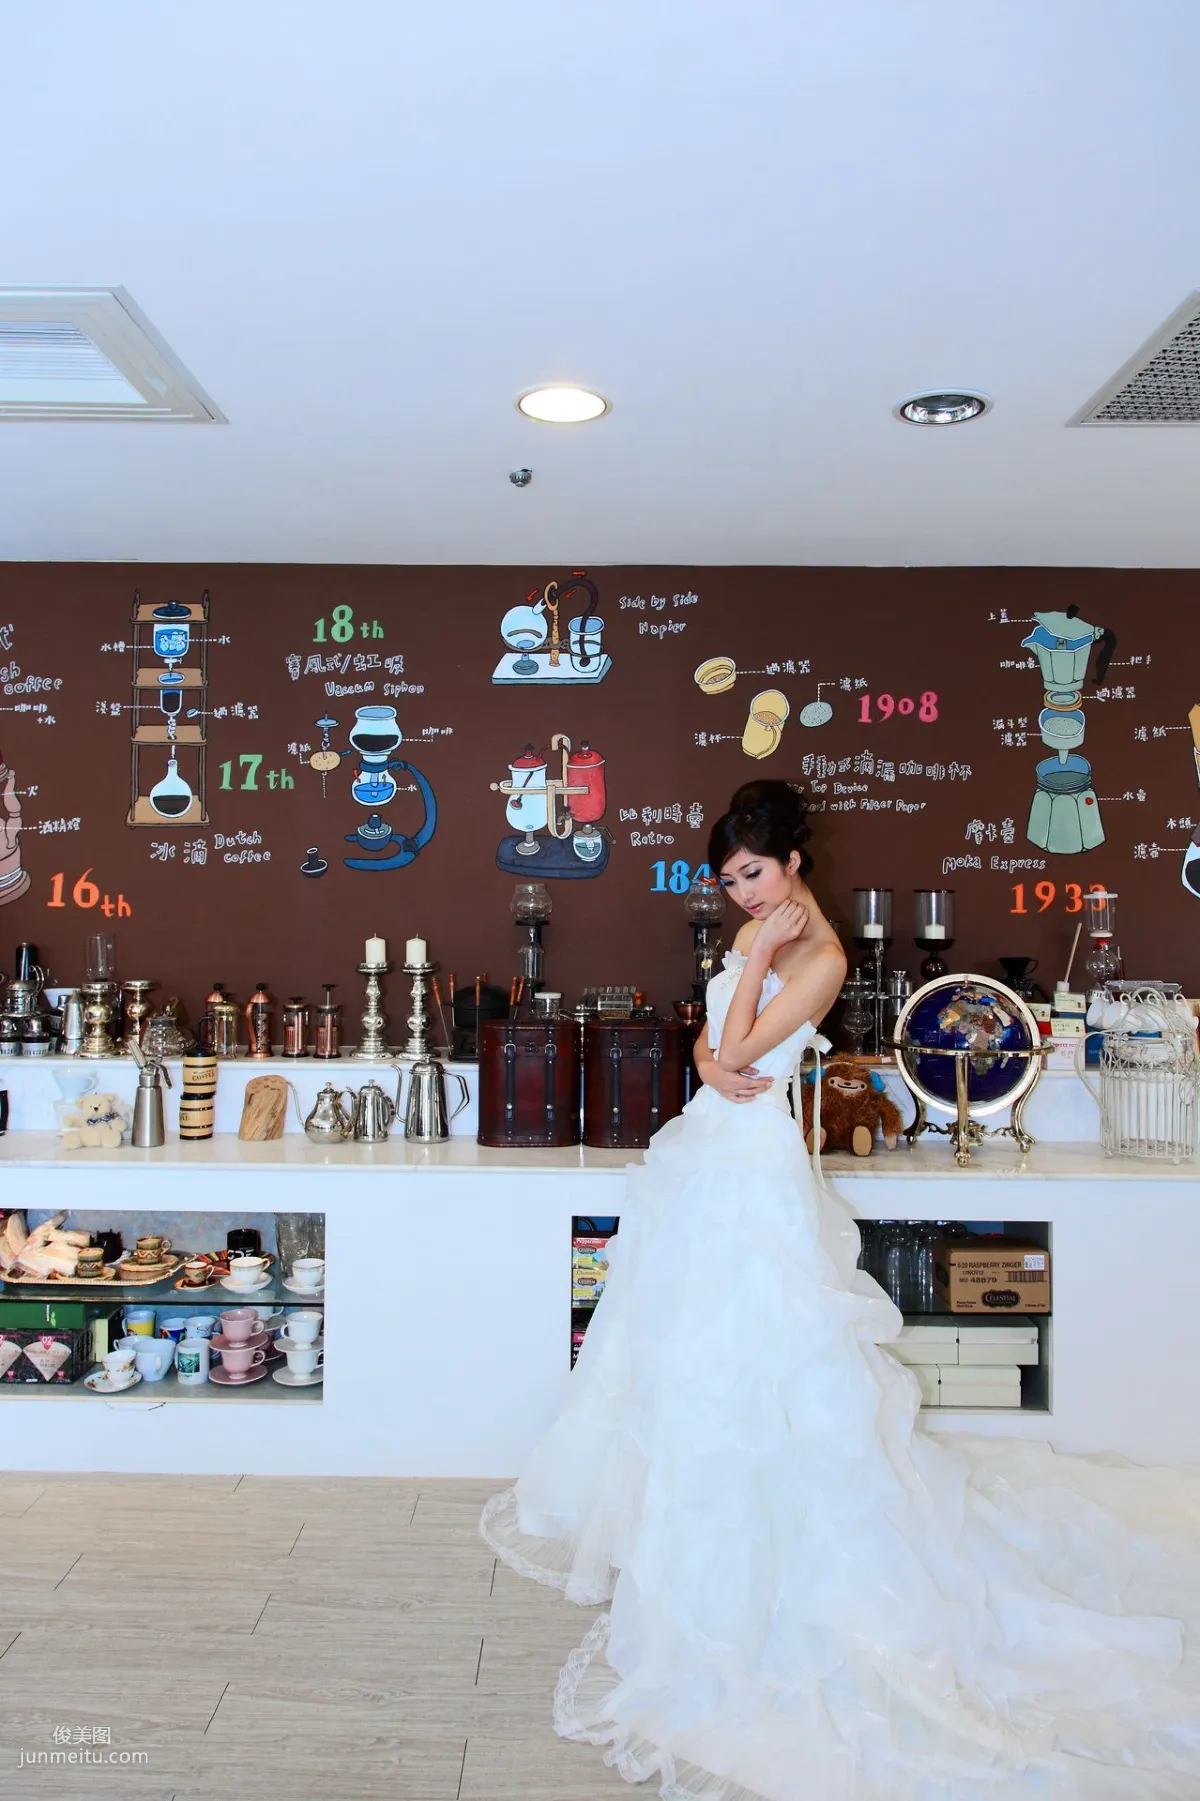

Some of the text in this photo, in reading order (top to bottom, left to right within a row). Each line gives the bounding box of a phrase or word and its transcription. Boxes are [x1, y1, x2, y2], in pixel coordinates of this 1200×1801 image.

[619, 591, 698, 611] Side by Side
[312, 604, 385, 643] 18th
[218, 635, 231, 645] 水
[218, 754, 295, 791] 17th
[407, 784, 418, 792] 水
[830, 798, 857, 811] with
[214, 830, 263, 850] Dutch
[990, 855, 1047, 874] Express
[47, 867, 132, 918] 16th
[42, 1336, 53, 1345] 02
